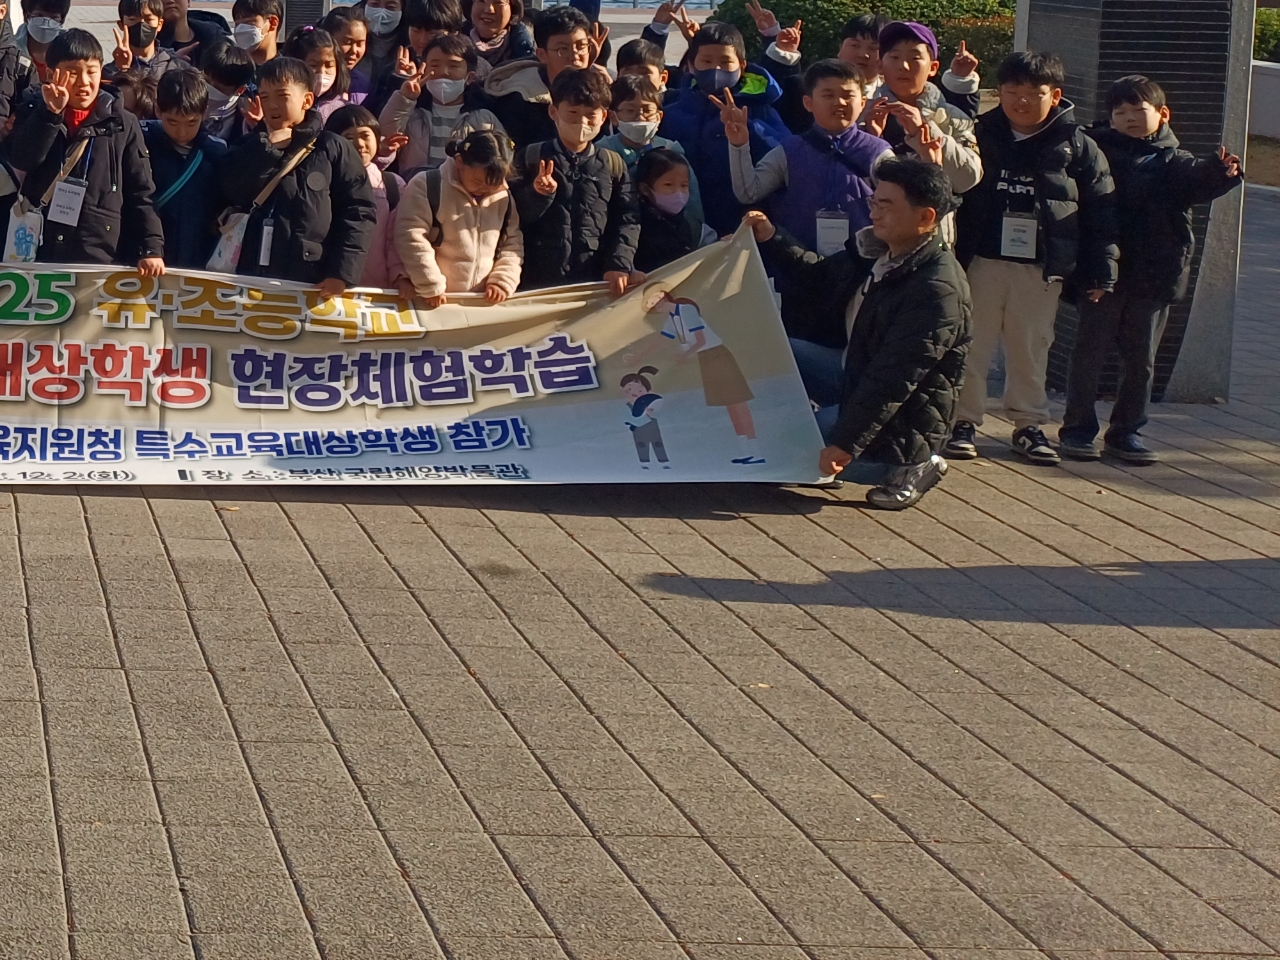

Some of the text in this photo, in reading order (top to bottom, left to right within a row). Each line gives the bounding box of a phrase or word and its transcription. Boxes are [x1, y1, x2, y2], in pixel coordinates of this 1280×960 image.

[229, 333, 596, 409] 현장체험학습
[134, 426, 437, 460] 특수교육대상학생
[447, 416, 529, 451] 참가
